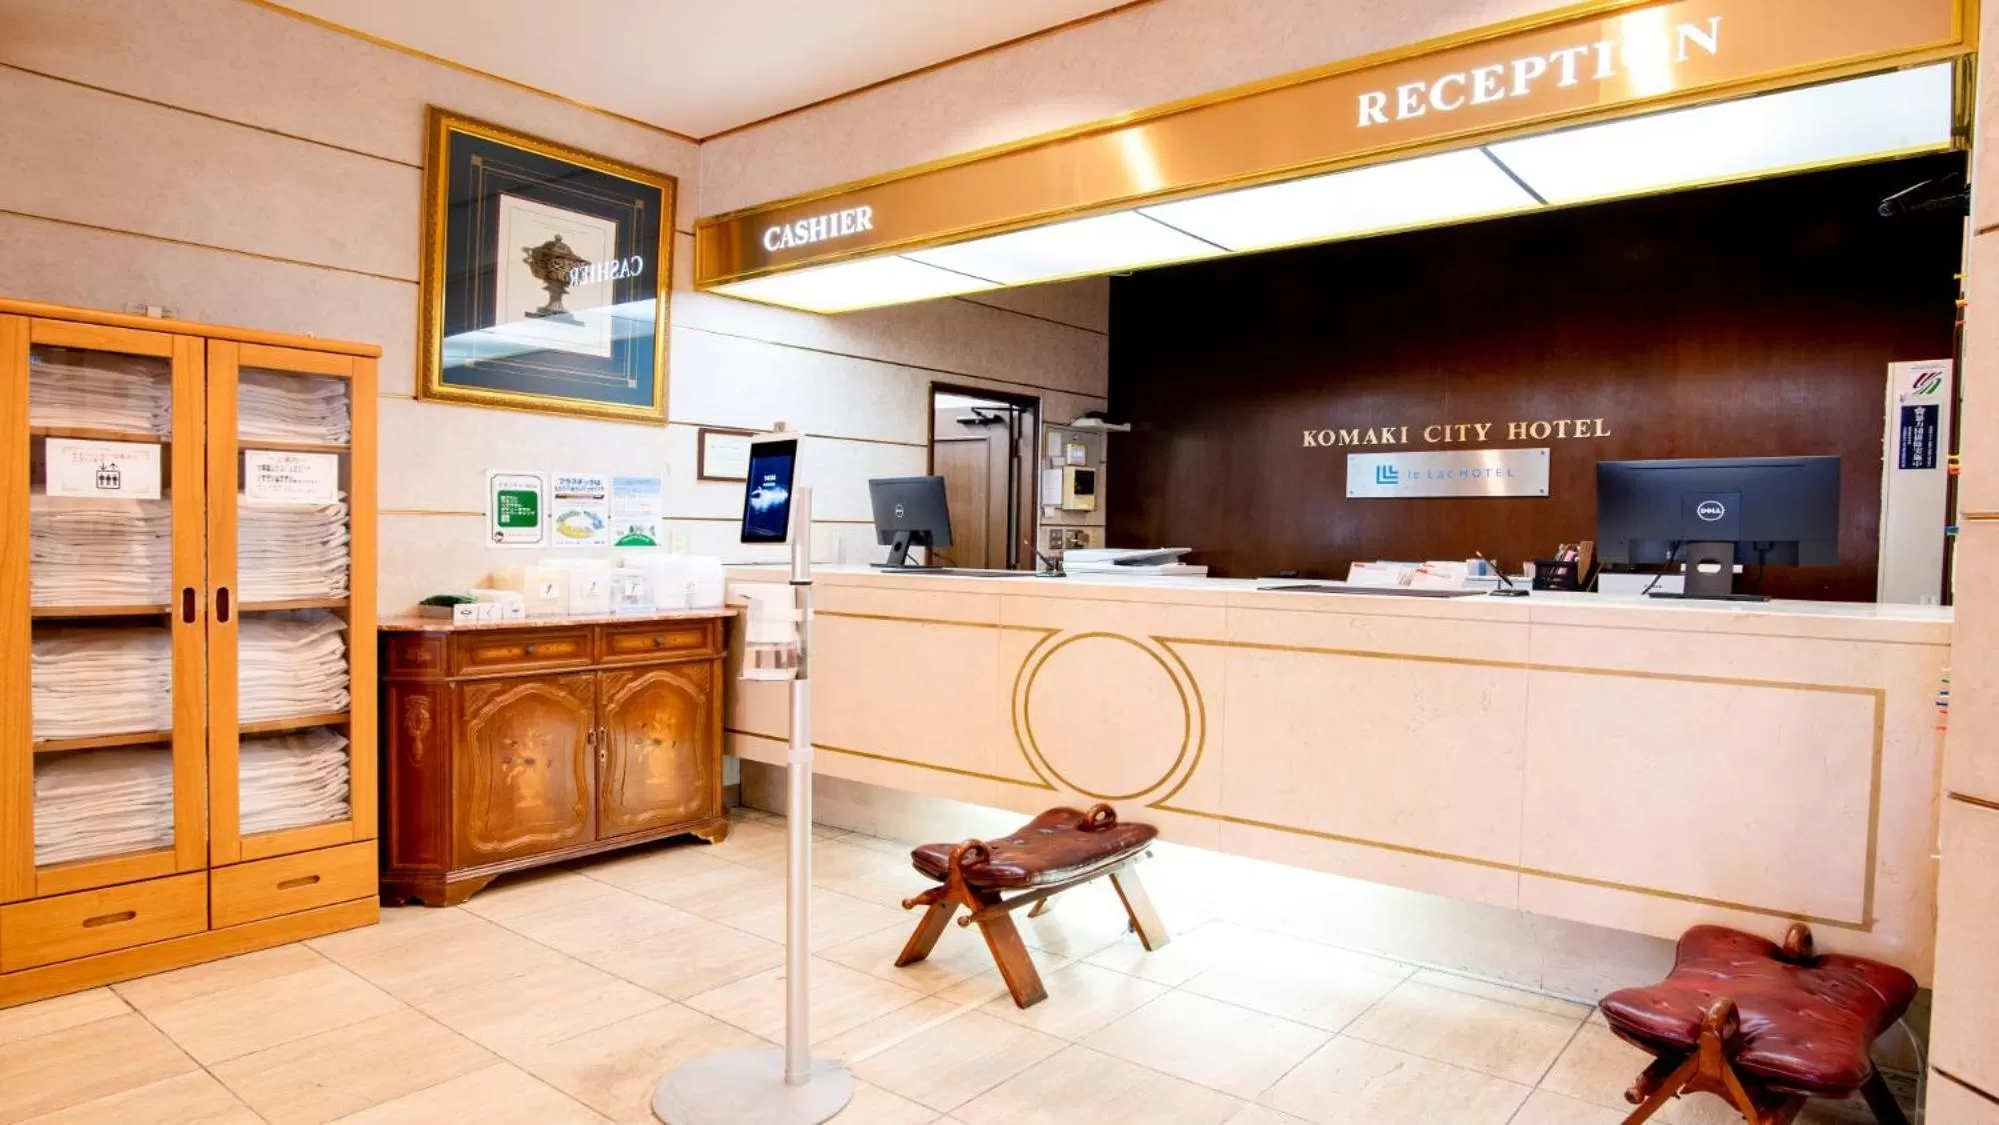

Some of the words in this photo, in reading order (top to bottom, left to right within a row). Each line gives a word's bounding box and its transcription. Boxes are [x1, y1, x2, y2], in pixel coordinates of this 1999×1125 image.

[1356, 16, 1722, 128] RECEPTIN
[762, 206, 873, 253] CASHIER
[1302, 427, 1409, 446] KOMAKI
[1423, 423, 1492, 443] CITY
[1508, 418, 1610, 441] HOTEL
[1459, 467, 1515, 479] HOTEL
